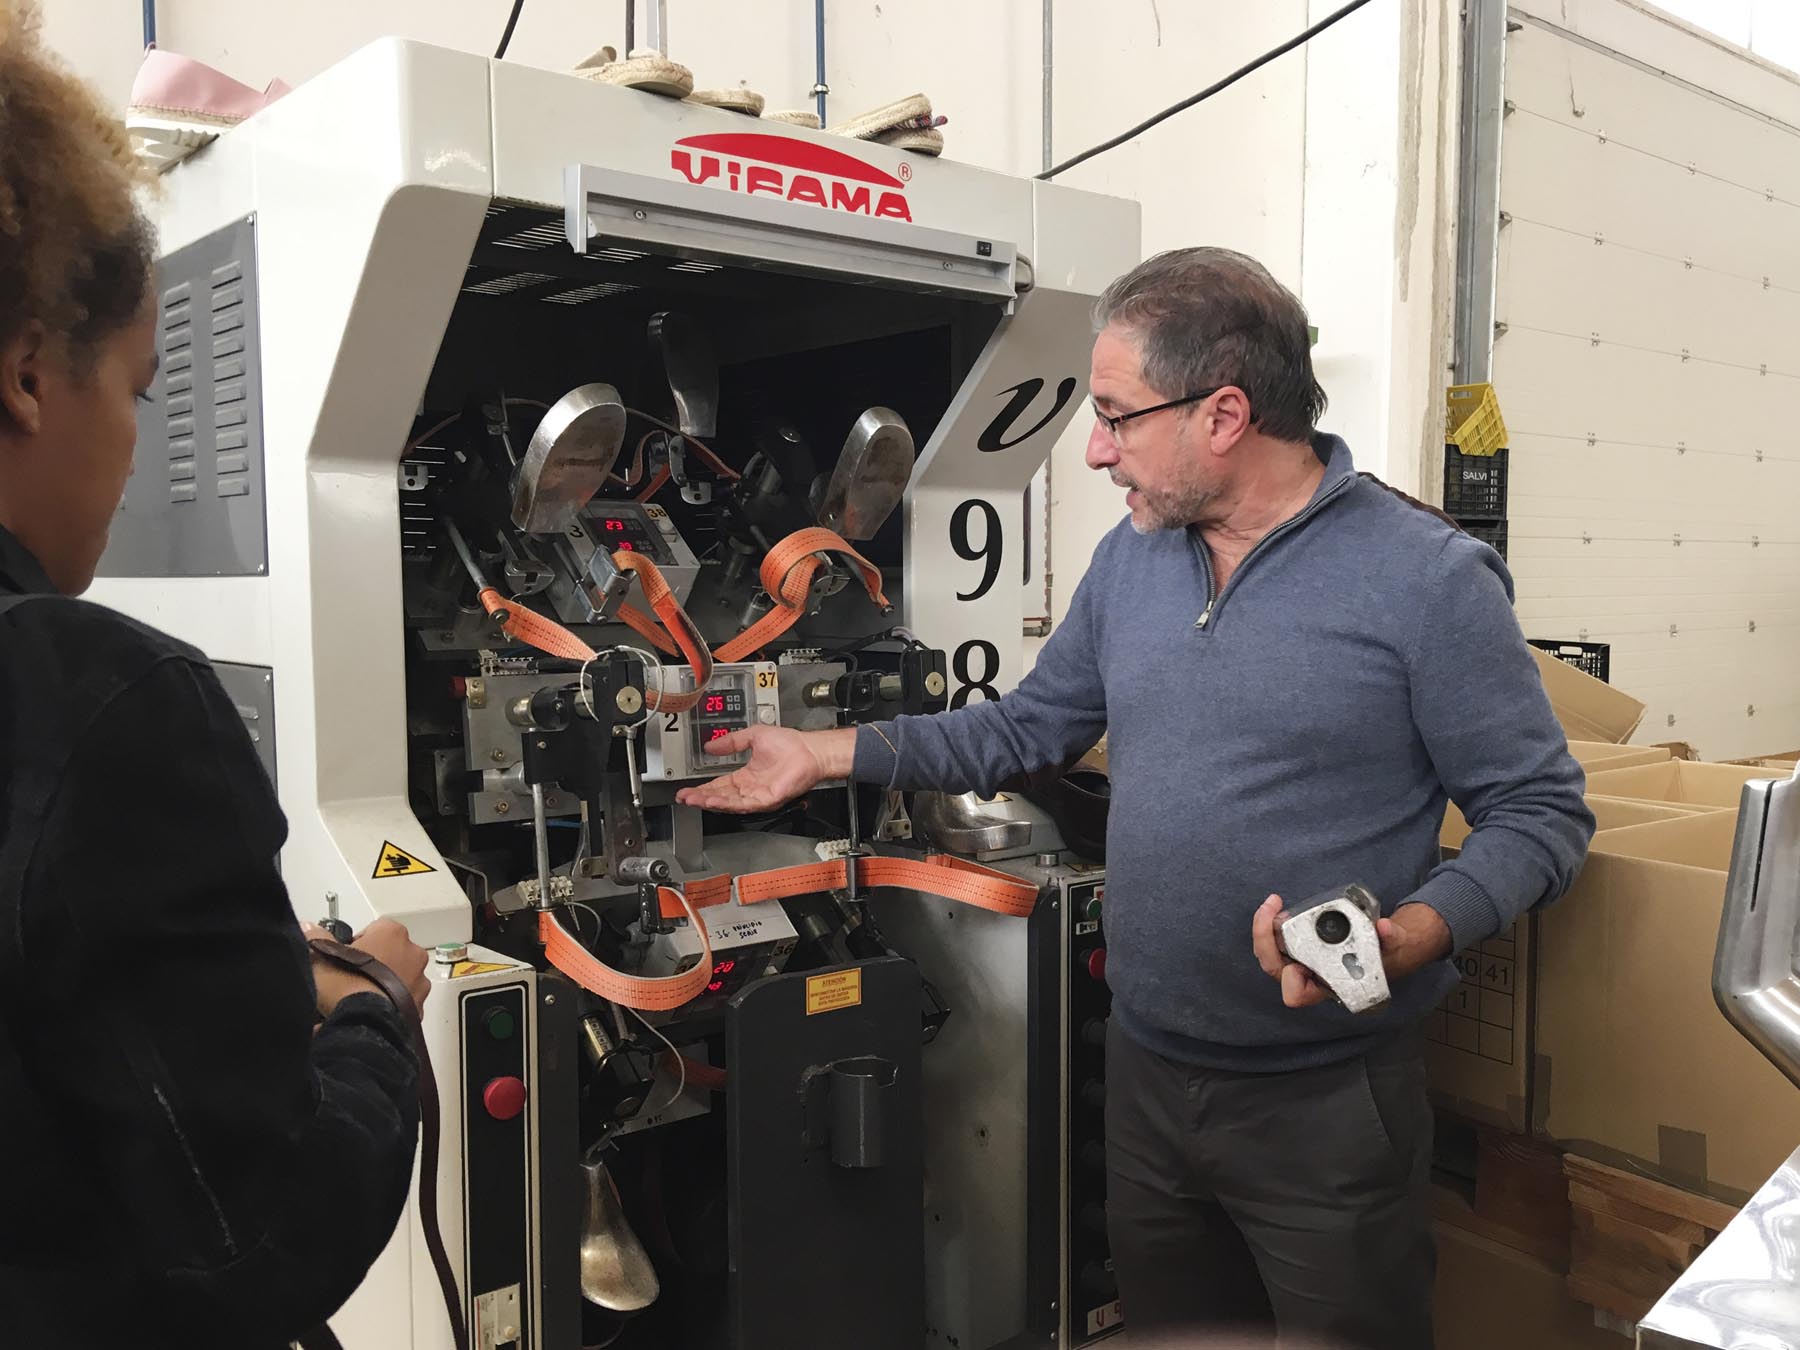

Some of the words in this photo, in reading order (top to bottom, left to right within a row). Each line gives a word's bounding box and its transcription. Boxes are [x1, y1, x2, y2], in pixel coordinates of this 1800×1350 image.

[1462, 471, 1488, 481] SALVI
[647, 507, 667, 518] 38
[569, 524, 585, 538] 3
[758, 671, 776, 688] 37
[705, 696, 724, 712] 26
[664, 712, 679, 733] 2
[773, 944, 794, 957] 36
[1485, 964, 1508, 986] 41
[1459, 990, 1467, 1009] 1
